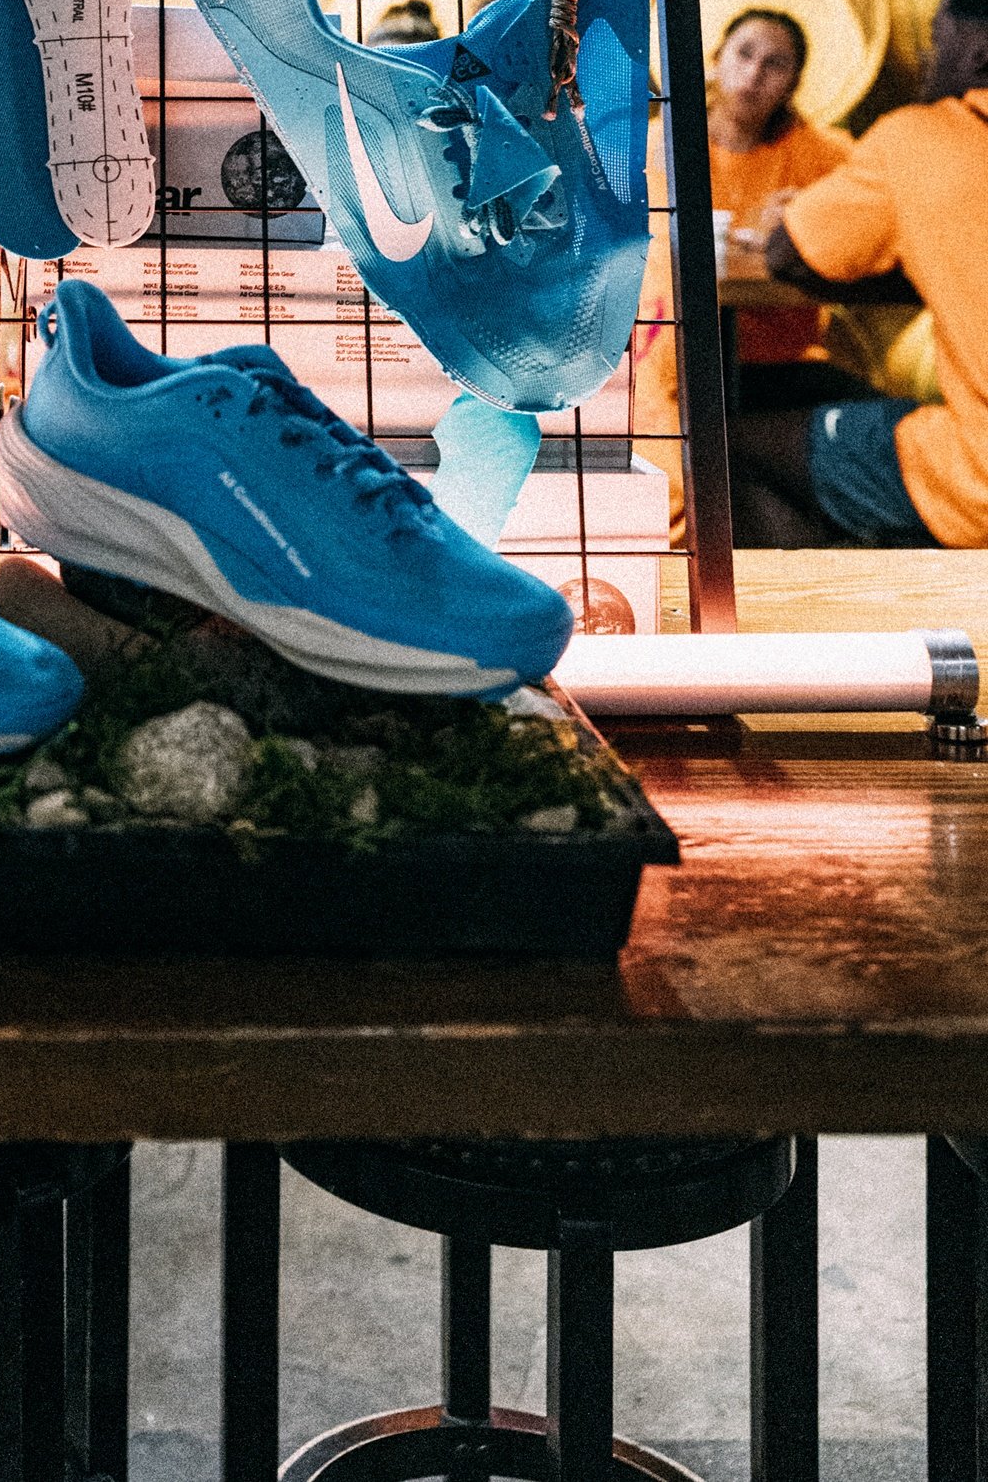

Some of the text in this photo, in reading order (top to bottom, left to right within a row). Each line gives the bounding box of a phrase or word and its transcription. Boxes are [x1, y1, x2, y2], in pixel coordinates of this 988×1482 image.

[74, 73, 97, 112] M10#
[576, 118, 609, 191] All Condition
[155, 186, 203, 216] ar
